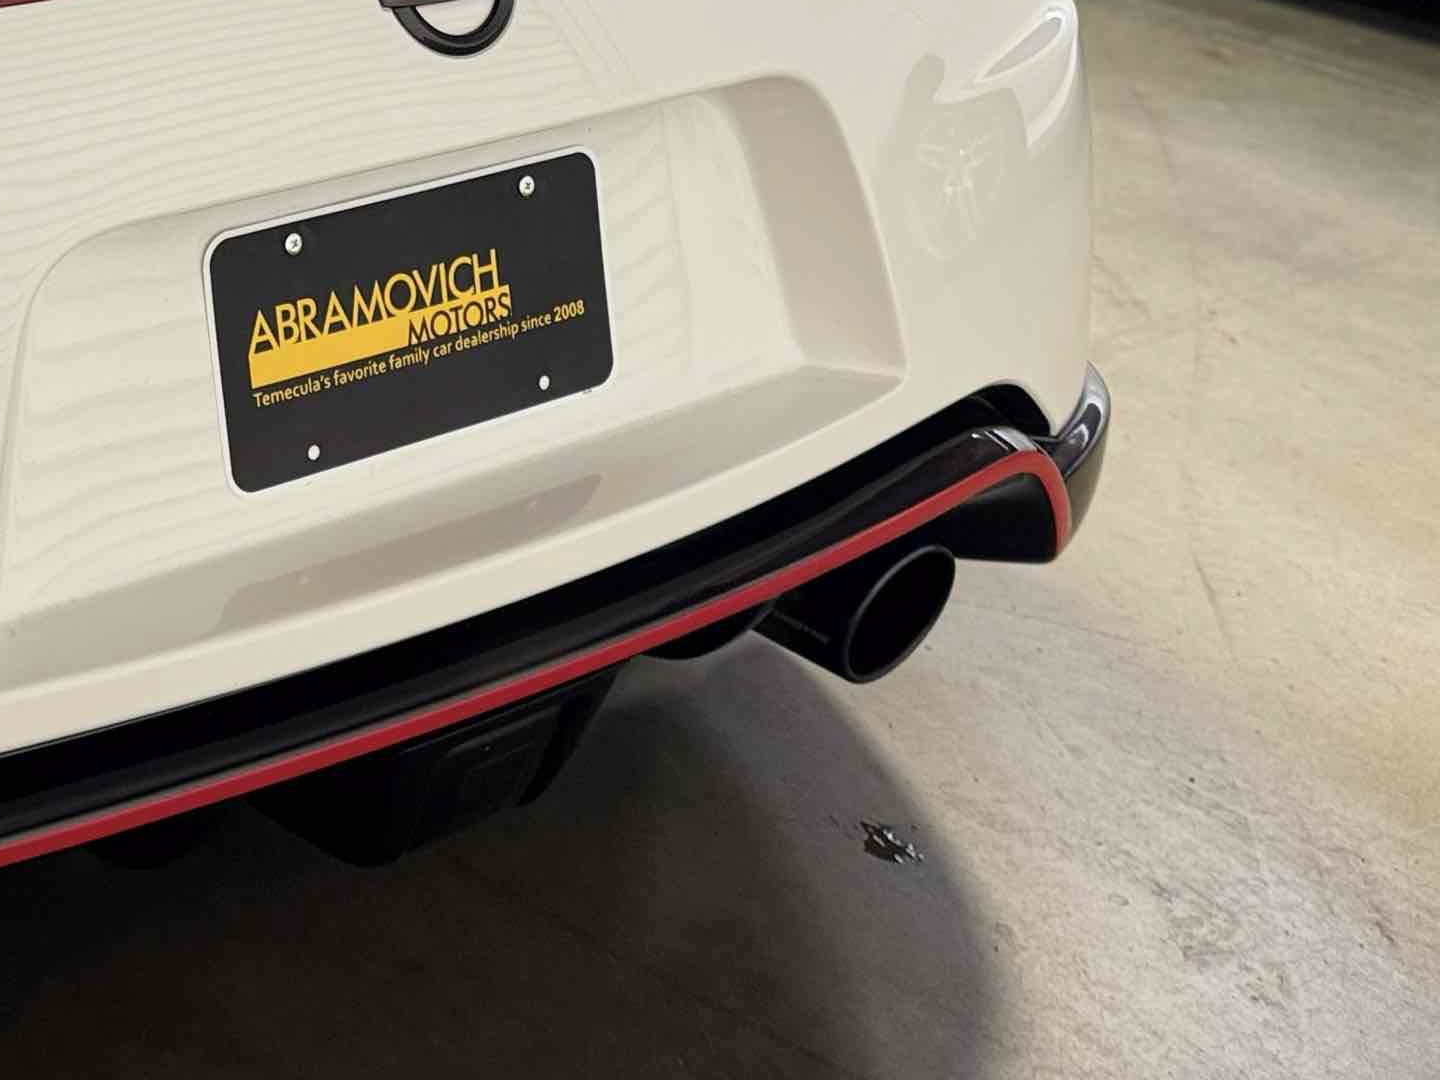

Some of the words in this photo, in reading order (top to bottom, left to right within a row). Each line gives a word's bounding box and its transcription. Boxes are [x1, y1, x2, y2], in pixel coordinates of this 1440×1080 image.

[248, 248, 500, 356] ABRAMOVICH
[252, 376, 331, 407] Temecula's
[333, 361, 386, 386] favorite
[389, 348, 430, 370] family
[433, 342, 452, 357] car
[455, 321, 519, 351] dealership
[521, 311, 552, 332] since
[553, 299, 585, 322] 2008
[409, 291, 511, 345] MOTORS
